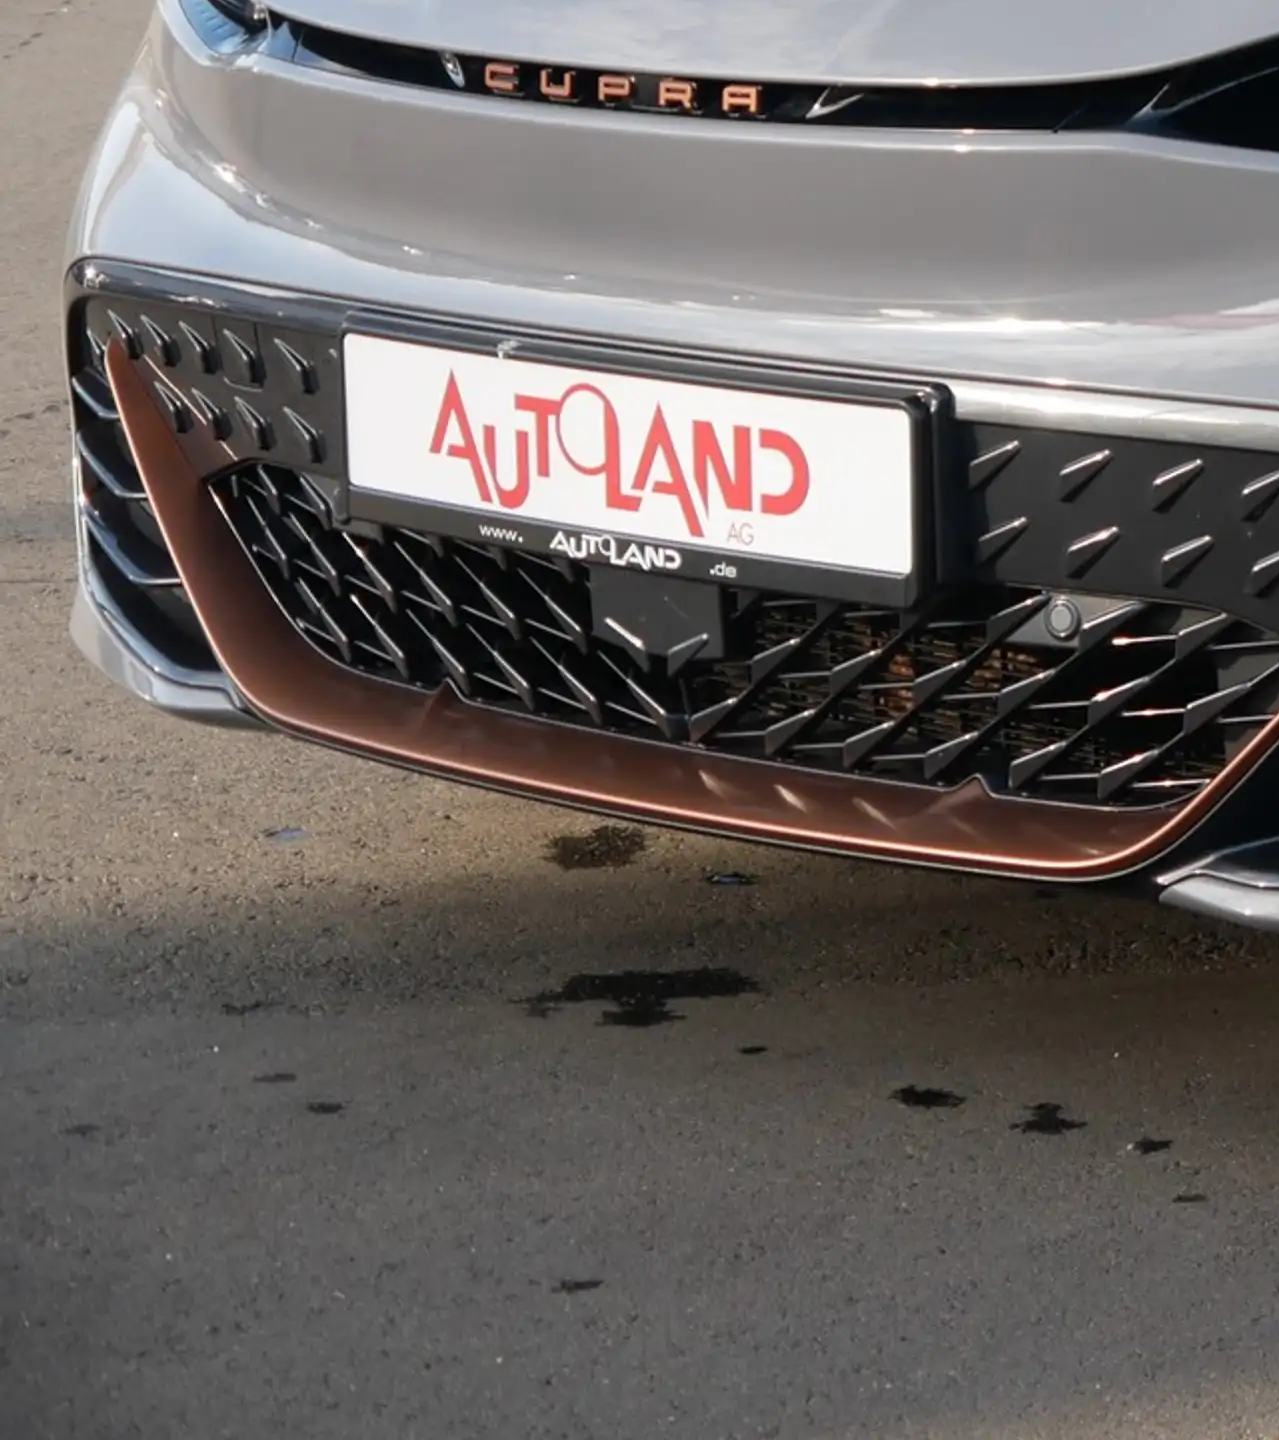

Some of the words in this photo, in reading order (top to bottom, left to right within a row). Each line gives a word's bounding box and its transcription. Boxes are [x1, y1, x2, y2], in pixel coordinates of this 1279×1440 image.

[484, 62, 763, 113] CUPRA
[429, 368, 811, 538] AUTOLAND
[479, 522, 524, 543] www.
[548, 530, 683, 570] AUTOLAND
[708, 561, 738, 579] .de
[726, 520, 755, 546] AG
